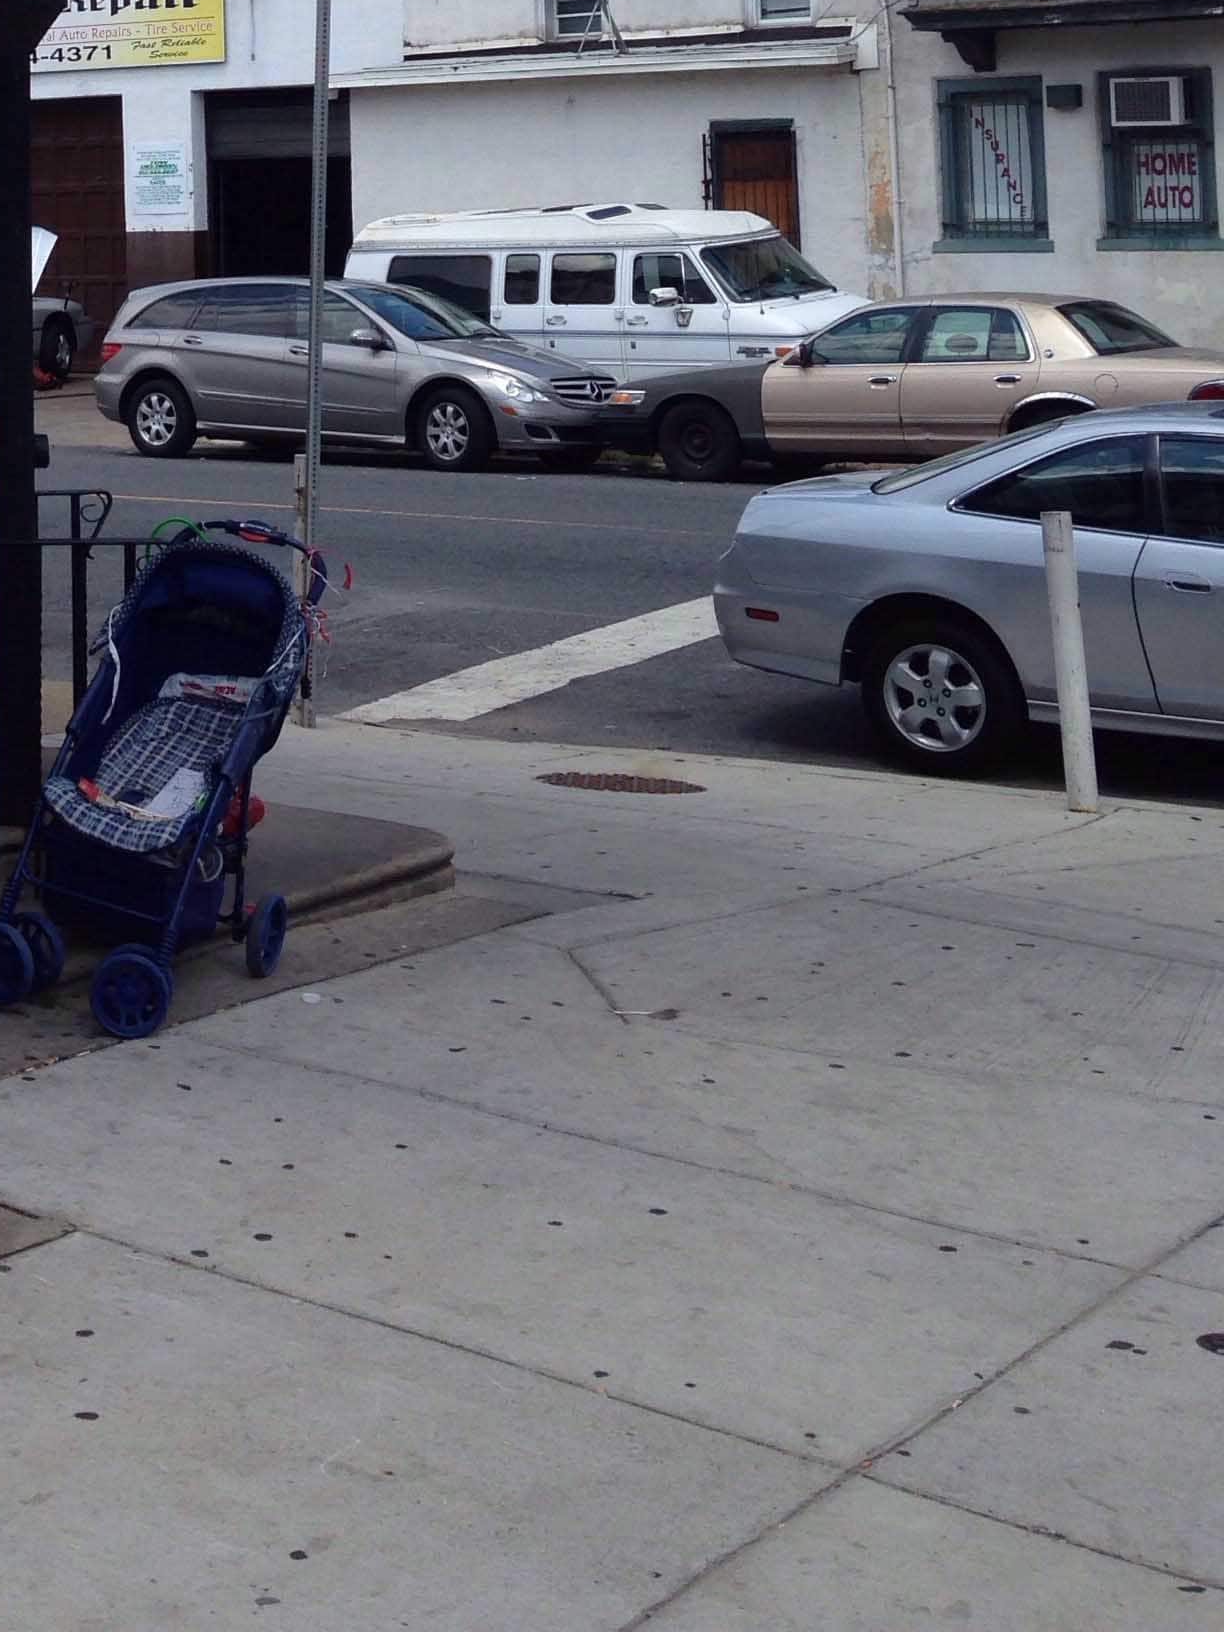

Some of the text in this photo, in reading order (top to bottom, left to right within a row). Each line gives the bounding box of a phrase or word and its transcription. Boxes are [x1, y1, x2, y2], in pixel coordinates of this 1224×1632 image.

[59, 29, 88, 41] Auto
[92, 25, 132, 41] Repairs
[144, 23, 168, 36] Tire
[171, 21, 213, 34] Service
[131, 37, 207, 51] Fast Reliable
[1137, 153, 1197, 176] HOME
[1144, 185, 1193, 209] AUTO
